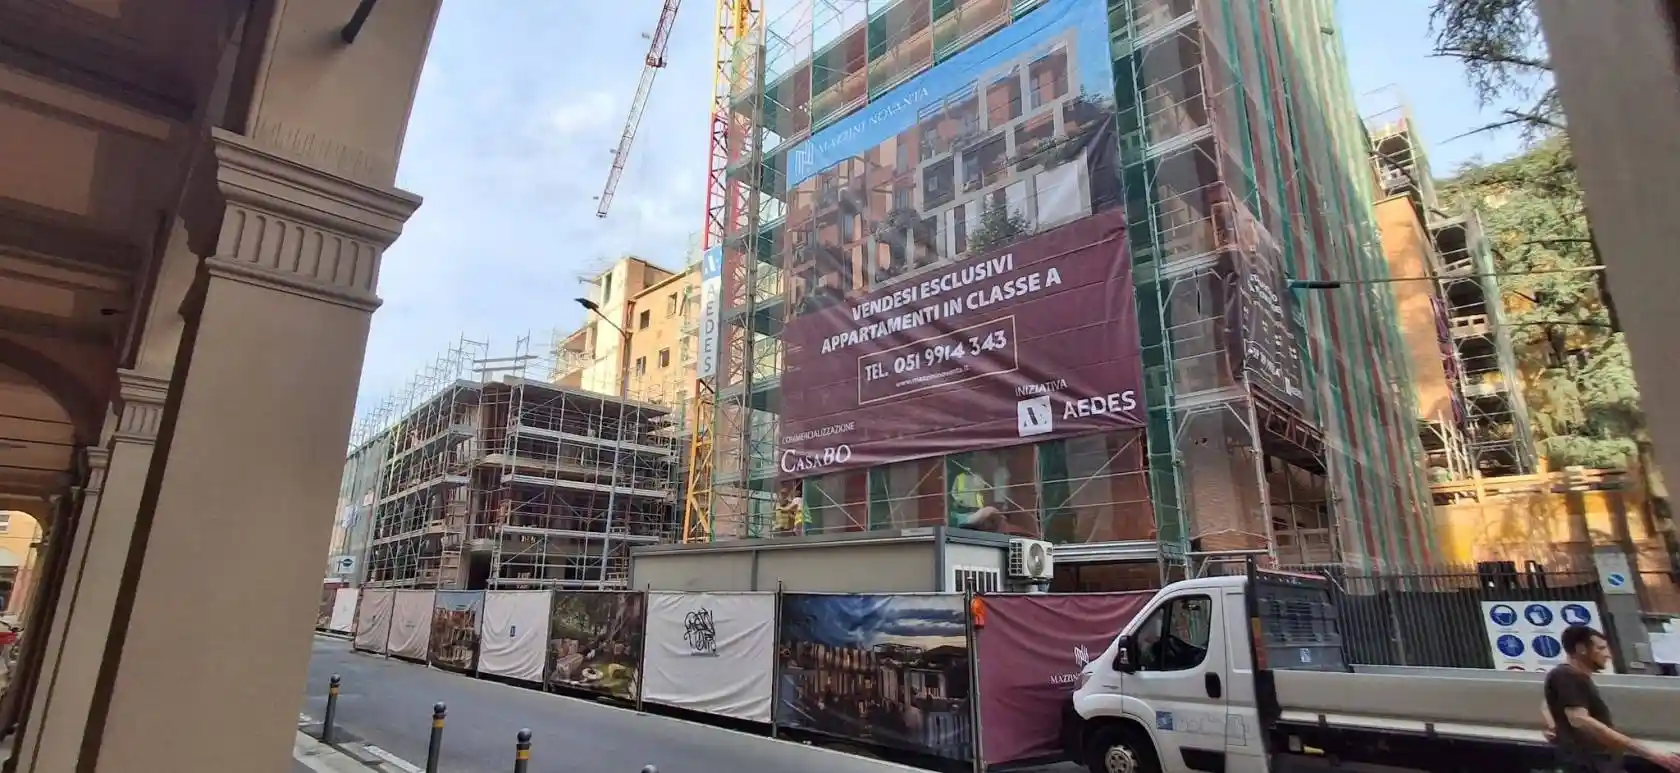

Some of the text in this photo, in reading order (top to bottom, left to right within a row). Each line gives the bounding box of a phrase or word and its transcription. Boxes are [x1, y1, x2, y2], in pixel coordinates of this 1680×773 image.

[821, 267, 1062, 354] APPARTAMENTI IN CLASSE A
[851, 253, 1013, 321] VENDESI ESCLUSIVI
[704, 284, 716, 372] AEDES
[864, 329, 1007, 382] TEL. 051 9914 343
[1015, 379, 1068, 397] INIZIATIVA
[1063, 390, 1137, 420] AEDES
